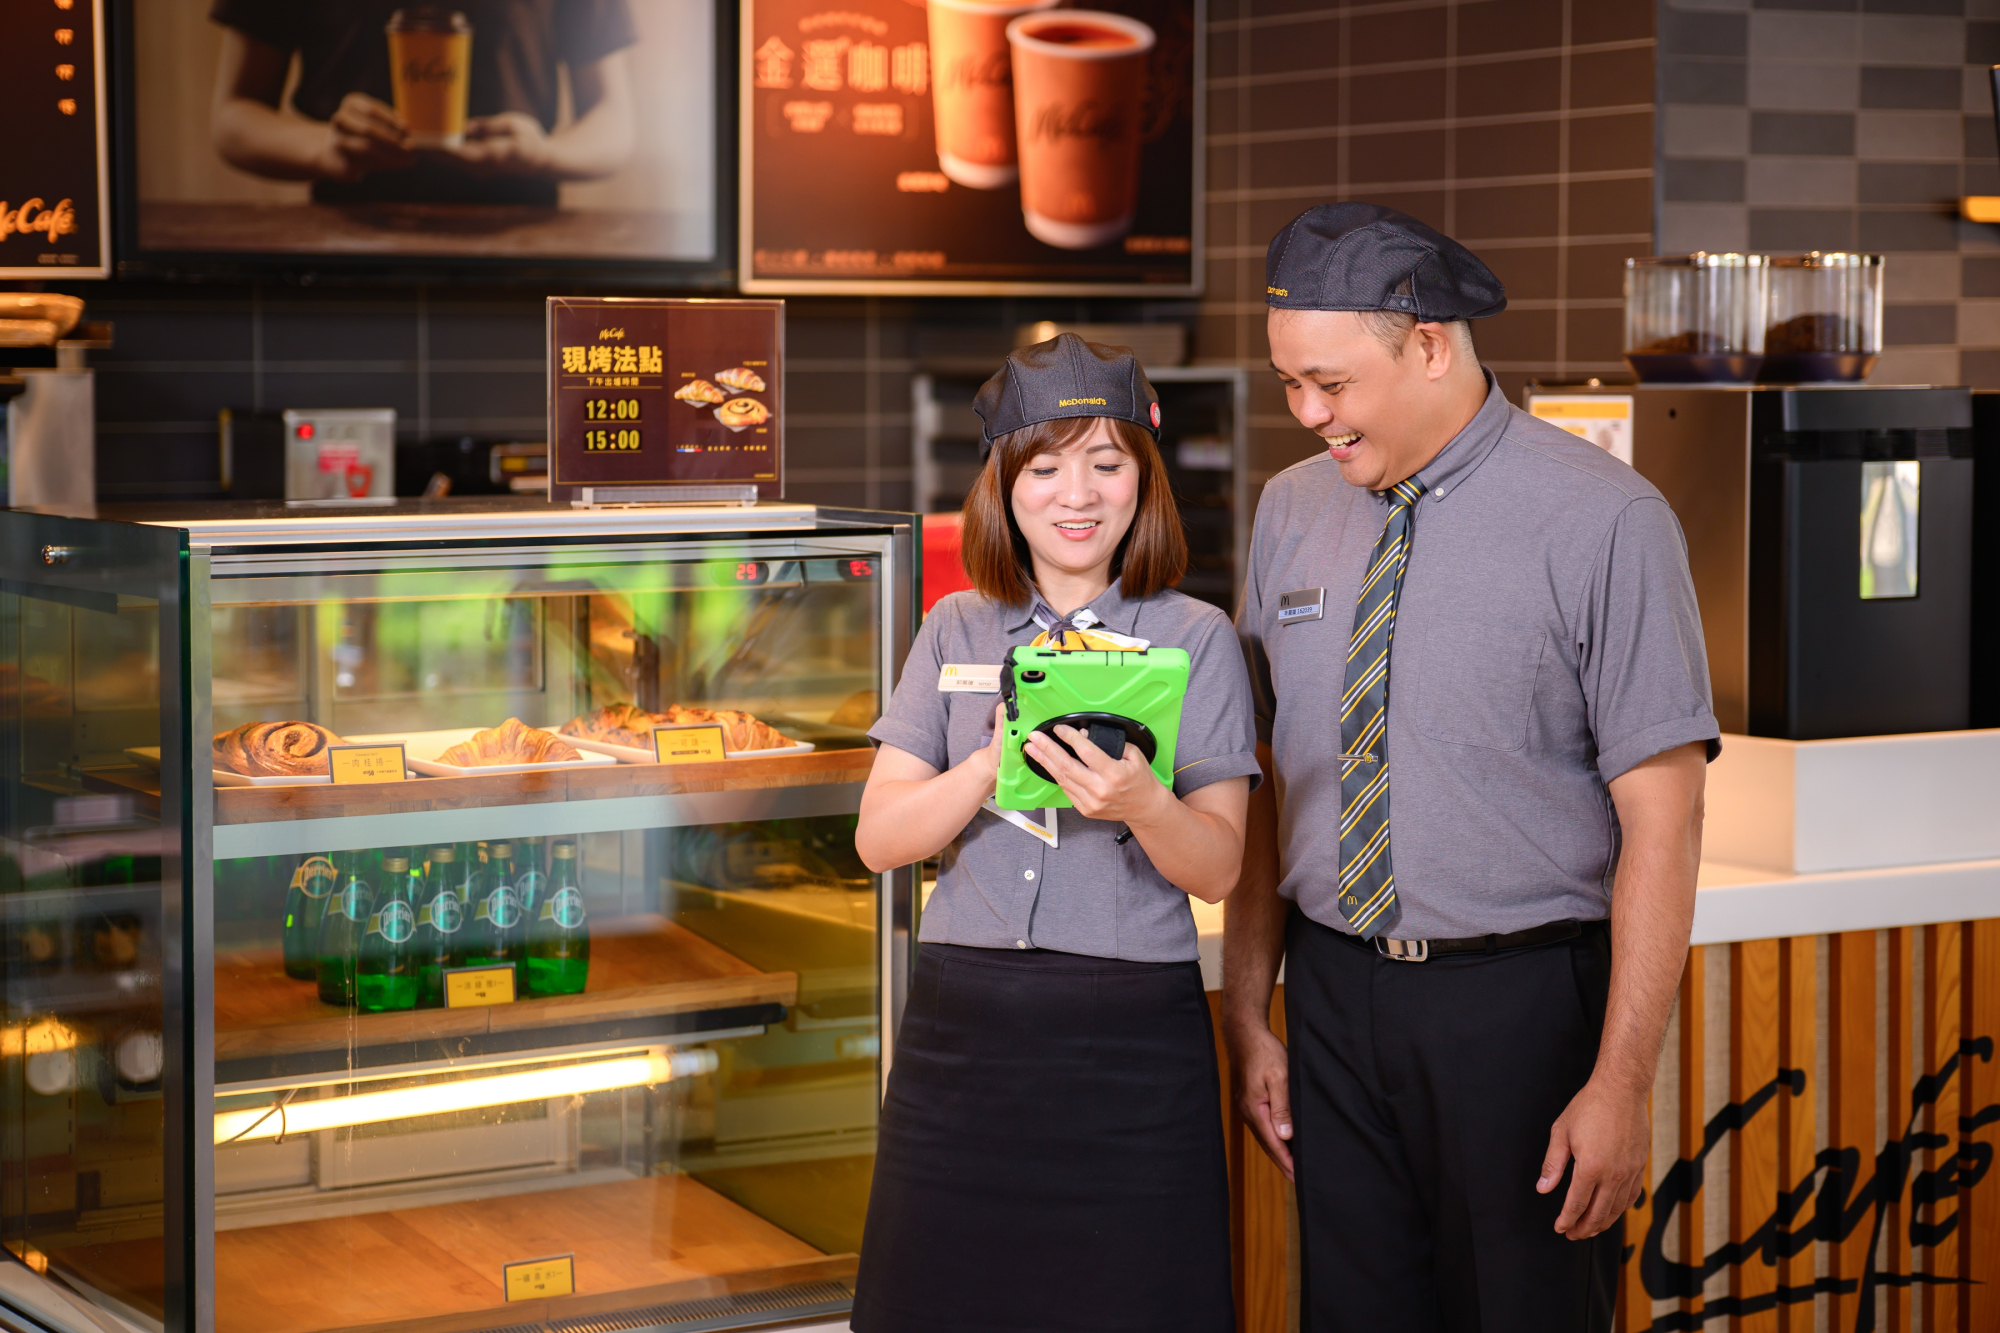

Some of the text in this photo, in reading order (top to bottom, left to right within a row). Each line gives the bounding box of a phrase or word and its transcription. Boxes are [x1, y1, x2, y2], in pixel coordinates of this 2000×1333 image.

[1267, 286, 1288, 297] Donald's
[599, 327, 626, 341] McCafé
[562, 345, 663, 373] 現烤法點
[586, 399, 640, 420] 12:00
[1059, 397, 1107, 407] McDonald's
[585, 429, 641, 450] 15:00
[383, 906, 411, 933] Perrier
[1620, 1036, 2000, 1333] Café
